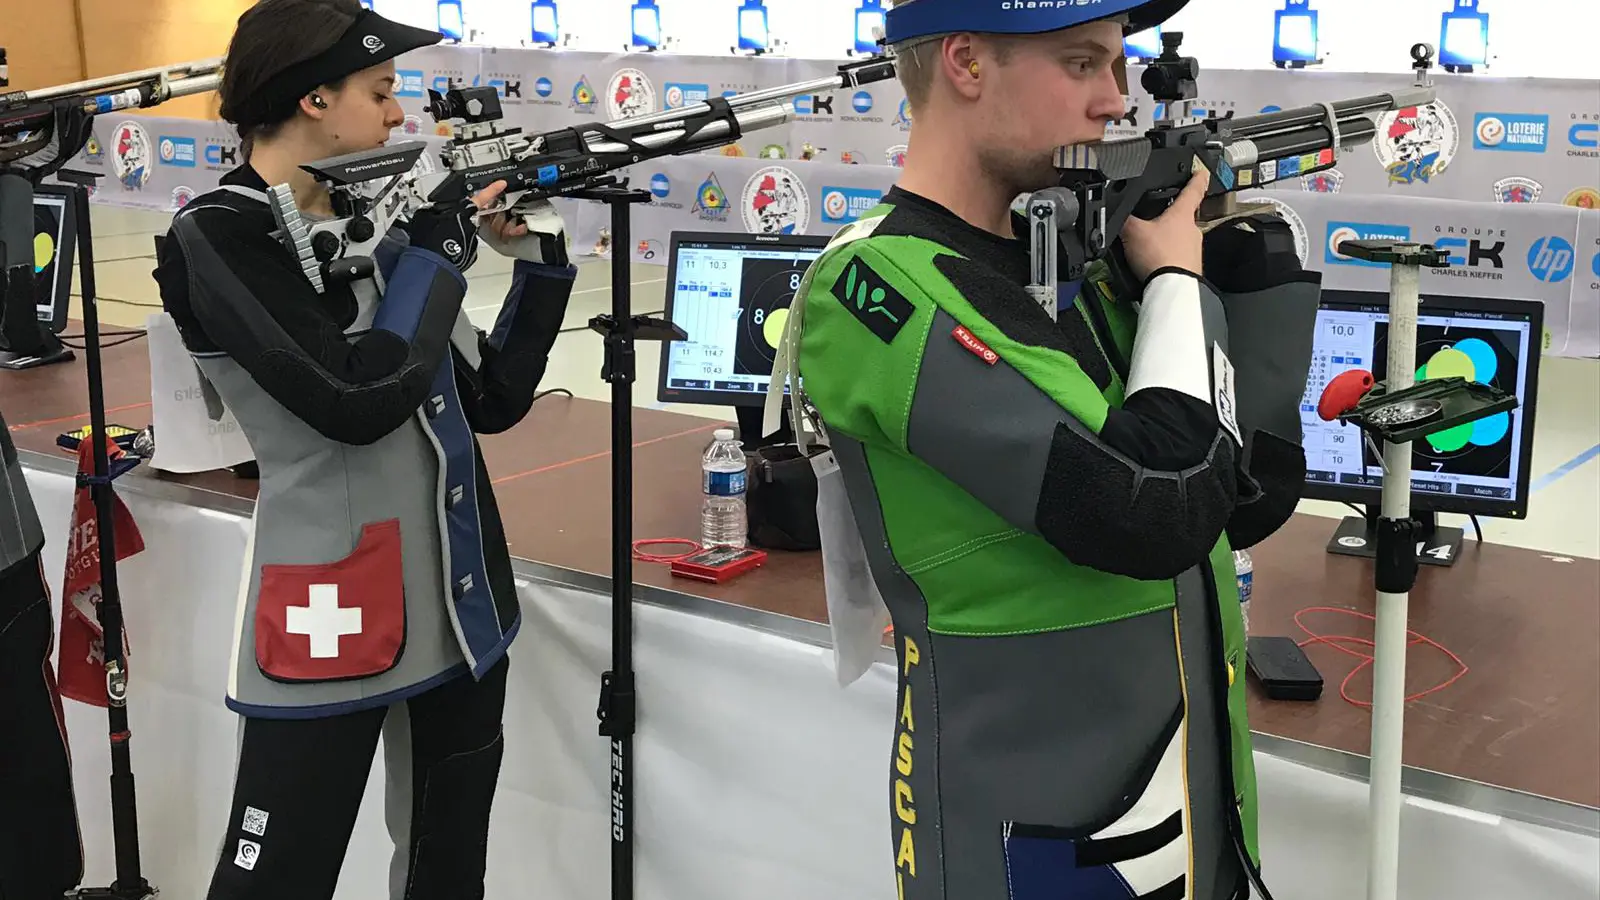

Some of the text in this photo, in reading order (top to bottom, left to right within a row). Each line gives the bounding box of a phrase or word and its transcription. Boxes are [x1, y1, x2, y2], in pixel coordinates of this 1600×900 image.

[792, 95, 834, 115] CK
[1508, 122, 1545, 135] LOTERIE
[1507, 134, 1545, 145] NATIONALE
[345, 156, 405, 174] Feinwerkbau
[464, 164, 518, 179] Feinwerkbau
[1434, 225, 1506, 237] GROUPE
[1532, 236, 1573, 283] hp
[790, 273, 800, 290] 8
[1431, 268, 1503, 281] CHARLES KIEFFER
[753, 308, 765, 325] 8
[1333, 434, 1345, 443] 90
[1332, 456, 1344, 465] 10
